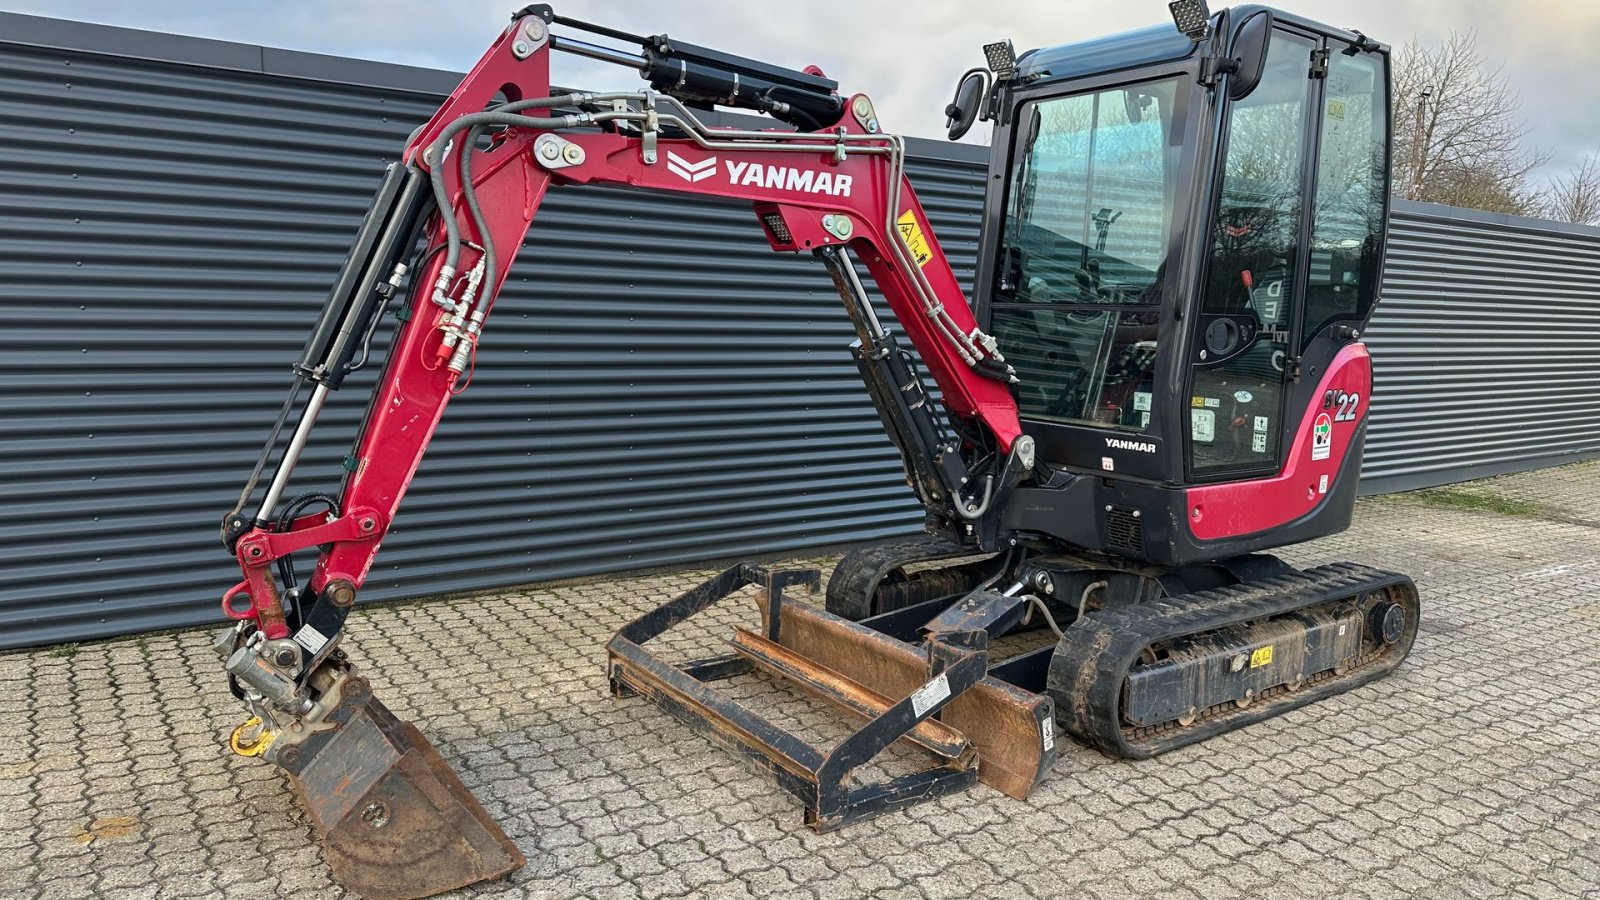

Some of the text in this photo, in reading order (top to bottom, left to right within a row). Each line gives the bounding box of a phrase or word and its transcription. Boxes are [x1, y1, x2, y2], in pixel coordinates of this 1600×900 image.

[725, 159, 853, 197] YANMAR
[1323, 389, 1359, 423] SV22
[1105, 437, 1156, 453] YANMAR
